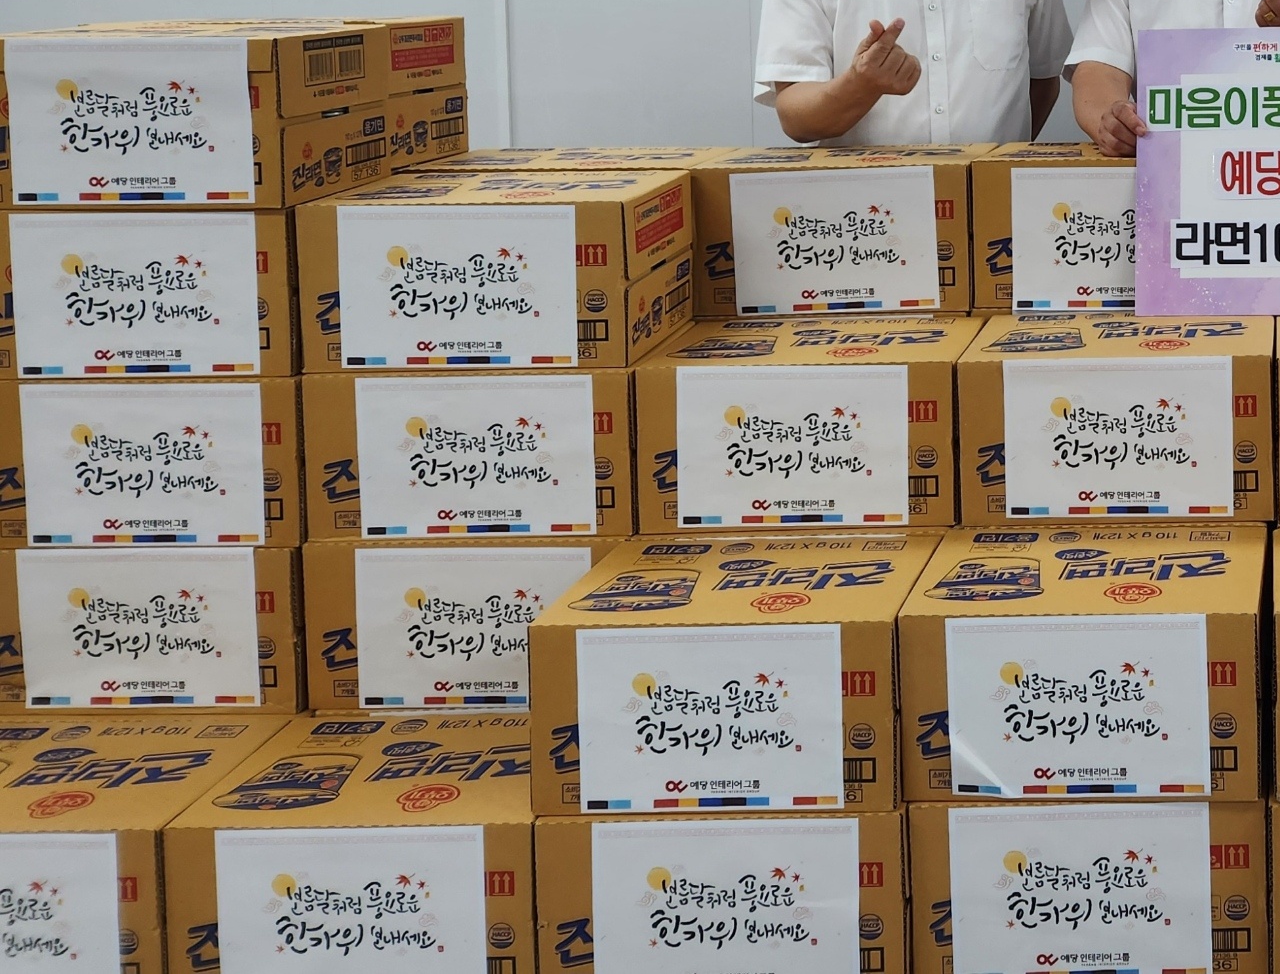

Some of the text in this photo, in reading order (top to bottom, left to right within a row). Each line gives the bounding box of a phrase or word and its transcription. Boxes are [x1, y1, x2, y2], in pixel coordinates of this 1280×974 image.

[1253, 41, 1278, 52] 편하게
[70, 86, 191, 122] 보름달처럼 풍요로운
[60, 118, 206, 155] 한가위 보내세요
[111, 177, 127, 186] 예당
[785, 210, 887, 241] 보름달처럼 풍요로운
[400, 253, 519, 288] 보름달처럼 풍요로운
[777, 239, 900, 271] 한가위 보내세요
[389, 284, 533, 320] 한가위 보내세요
[439, 341, 454, 350] 예당
[1063, 404, 1177, 438] 보름달처럼 풍요로운
[85, 431, 204, 466] 보름달처럼 풍요로운
[1053, 435, 1190, 470] 한가위 보내세요
[75, 462, 219, 498] 한가위 보내세요
[1099, 491, 1114, 500] 예당
[647, 680, 778, 718] 보름달처럼 풍요로운
[1015, 669, 1144, 707] 보름달처럼 풍요로운
[635, 716, 794, 756] 한가위 보내세요
[1003, 704, 1160, 744] 한가위 보내세요
[690, 780, 707, 790] 예당
[1058, 768, 1075, 778] 예당
[1018, 856, 1148, 893] 보름달처럼 풍요로운
[287, 881, 420, 919] 보름달처럼 풍요로운
[1006, 891, 1163, 930] 한가위 보내세요
[276, 916, 436, 956] 한가위 보내세요
[1060, 954, 1078, 963] 예당
